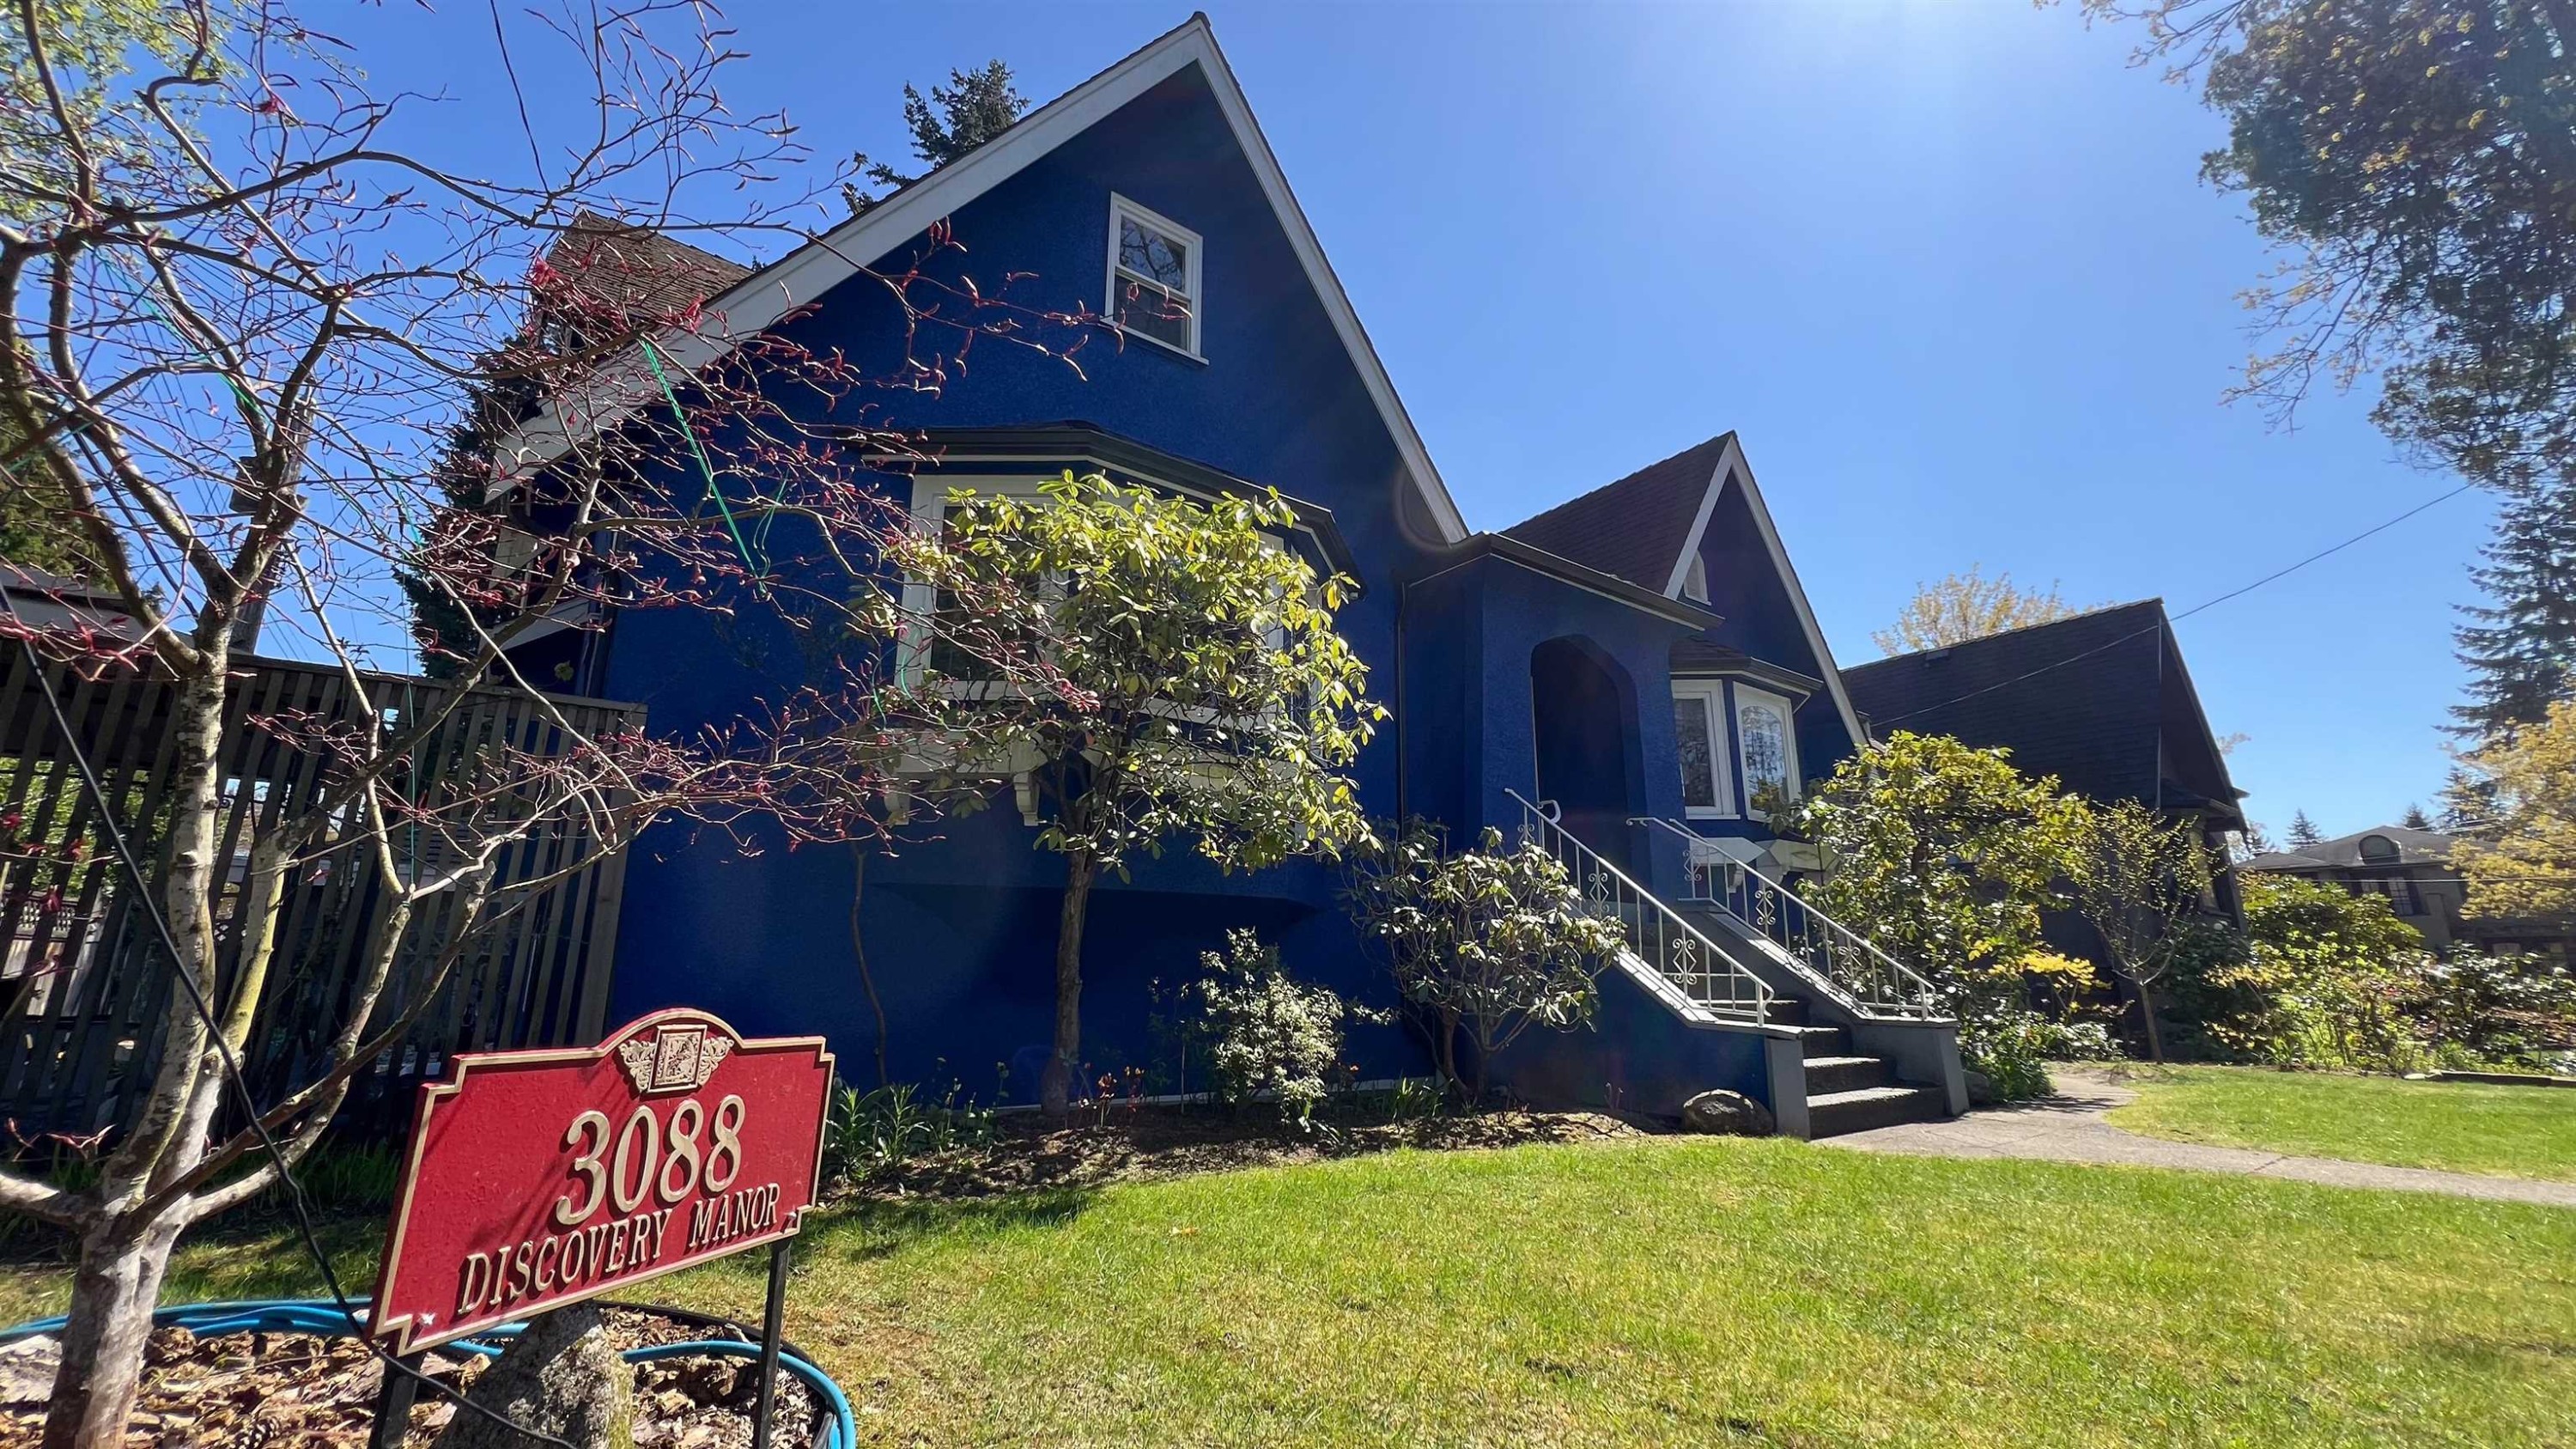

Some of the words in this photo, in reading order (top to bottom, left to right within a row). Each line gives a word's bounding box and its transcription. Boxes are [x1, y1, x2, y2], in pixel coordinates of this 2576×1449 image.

[556, 1095, 745, 1225] 3088
[459, 1209, 671, 1314] DISCOVERY
[689, 1183, 781, 1248] MANOR
